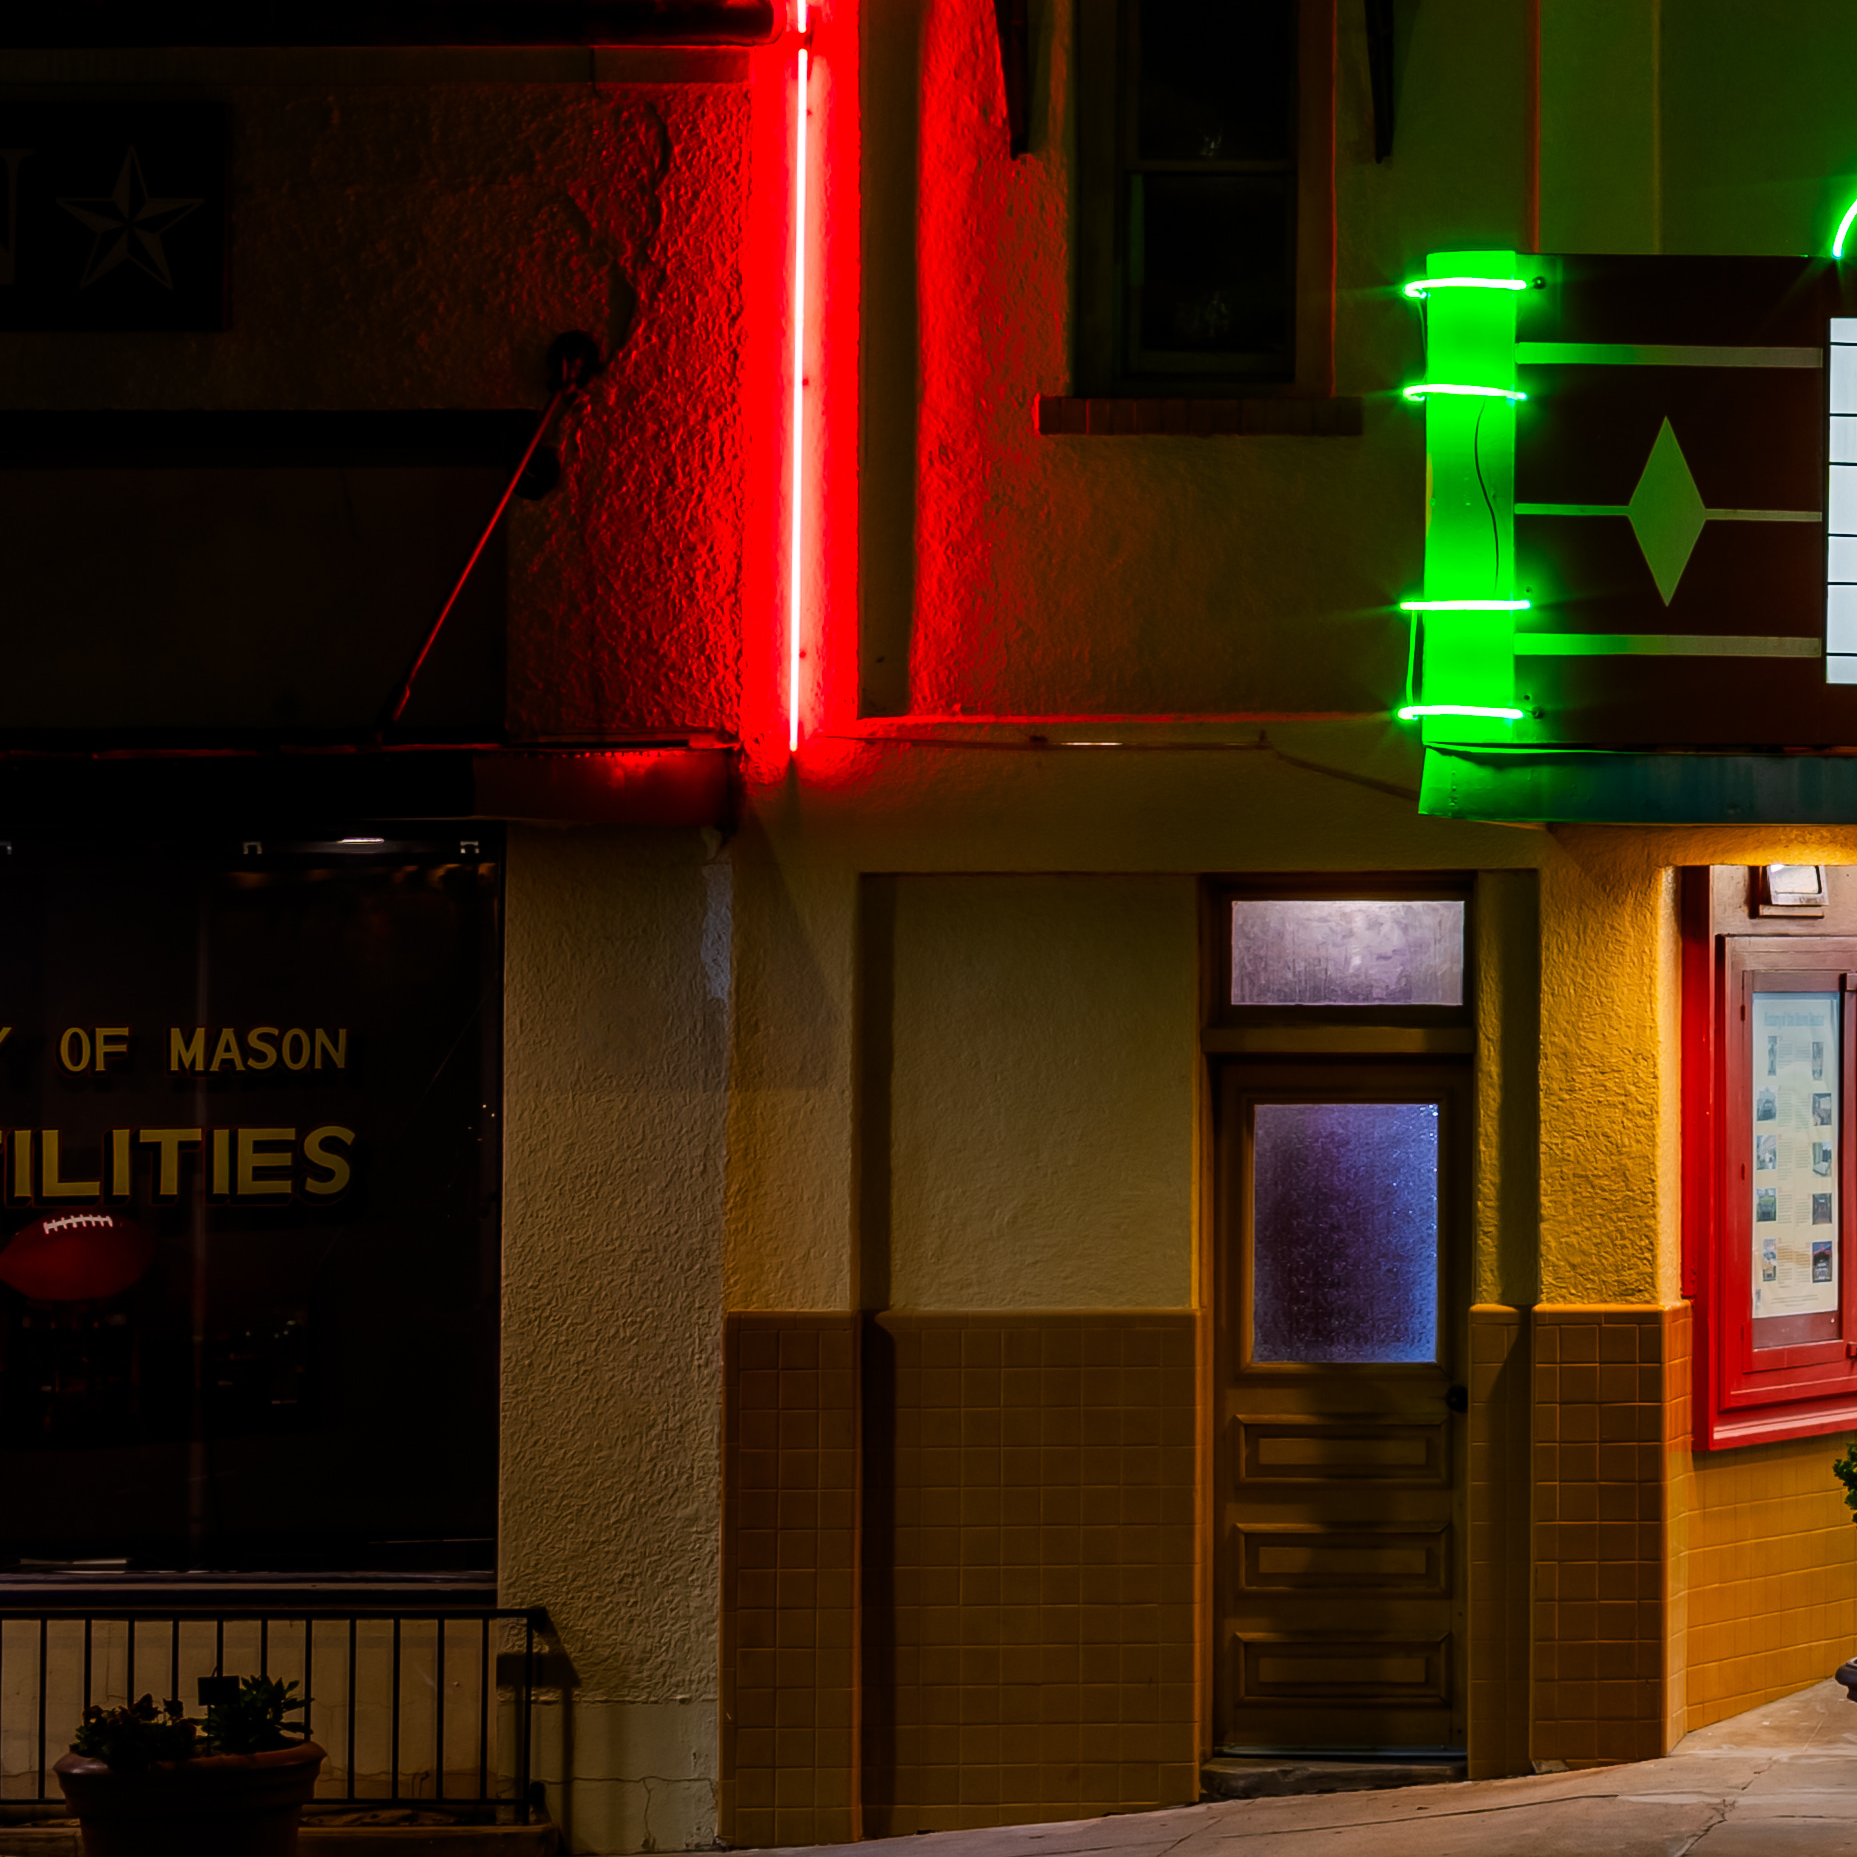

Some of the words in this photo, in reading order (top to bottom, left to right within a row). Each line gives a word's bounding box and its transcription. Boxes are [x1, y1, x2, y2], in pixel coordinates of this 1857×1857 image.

[58, 1025, 131, 1073] OF
[168, 1025, 349, 1073] MASON
[0, 1125, 357, 1198] ILITIES
